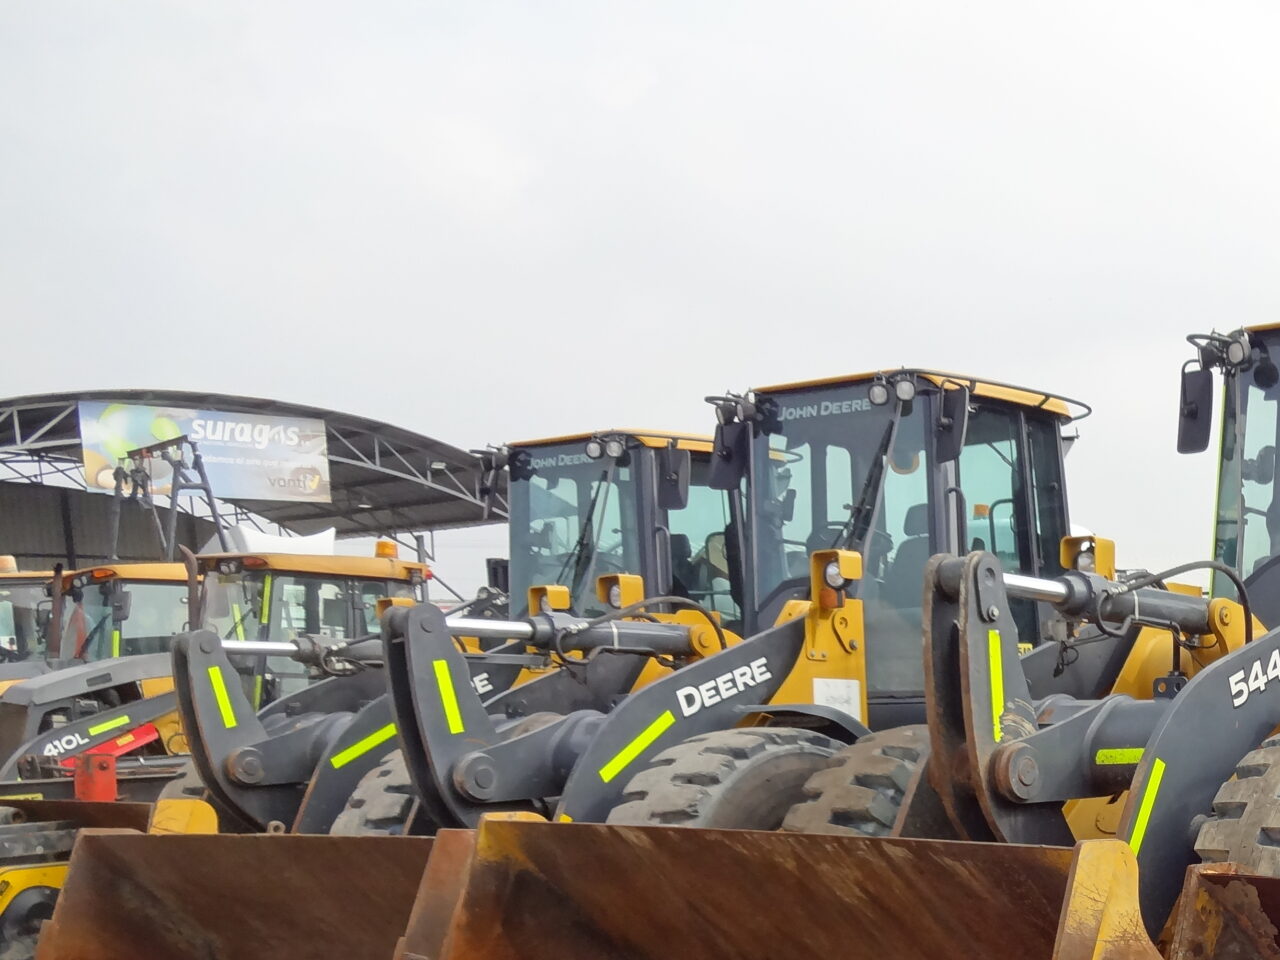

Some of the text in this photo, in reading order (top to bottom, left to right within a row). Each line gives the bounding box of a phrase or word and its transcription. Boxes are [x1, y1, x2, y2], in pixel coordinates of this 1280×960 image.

[777, 399, 872, 421] JOHN DEERE
[527, 453, 595, 470] JOHN DEER
[675, 656, 773, 718] DEERE
[43, 733, 90, 756] 410L
